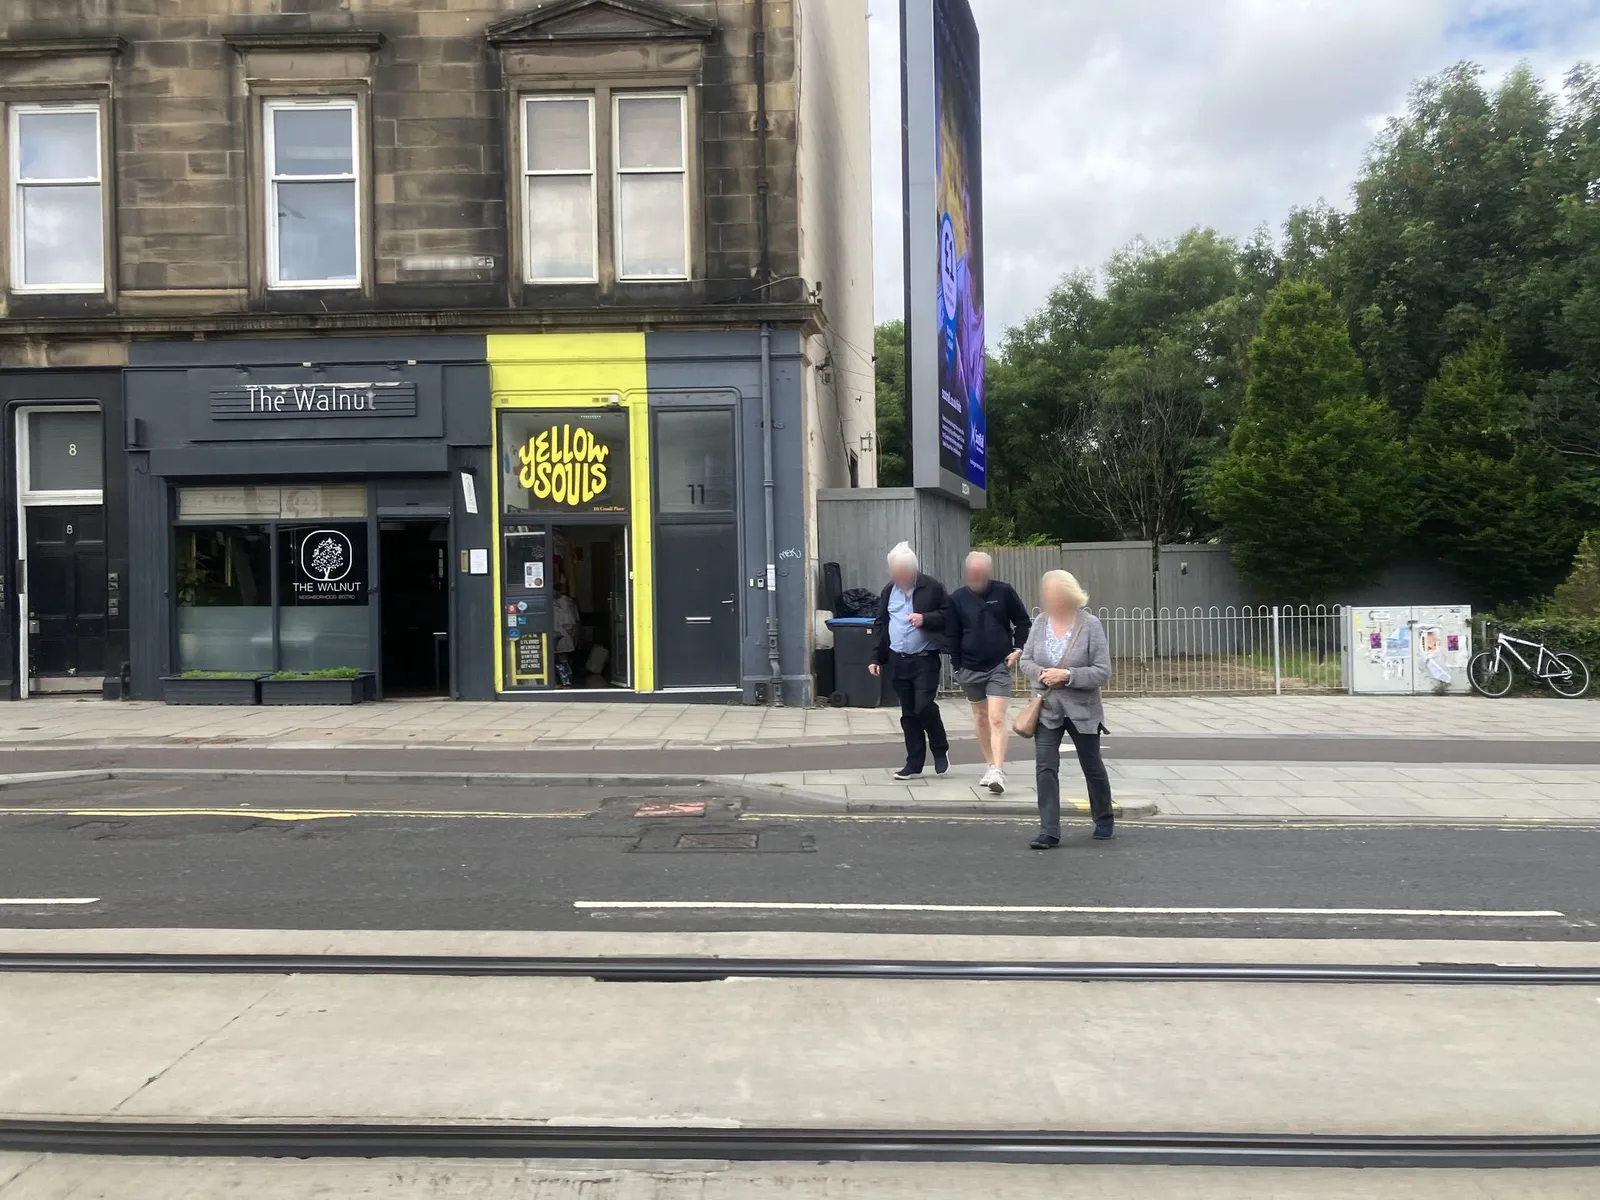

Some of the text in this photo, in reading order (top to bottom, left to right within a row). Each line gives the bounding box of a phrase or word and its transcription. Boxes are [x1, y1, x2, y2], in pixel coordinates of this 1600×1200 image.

[944, 231, 955, 283] £1
[246, 386, 377, 412] The Walnut
[68, 443, 77, 456] 8
[518, 423, 609, 489] YELLOW
[533, 461, 607, 506] SOULS
[687, 484, 705, 505] 11
[66, 524, 73, 535] 8
[292, 582, 362, 592] THE WALNUT
